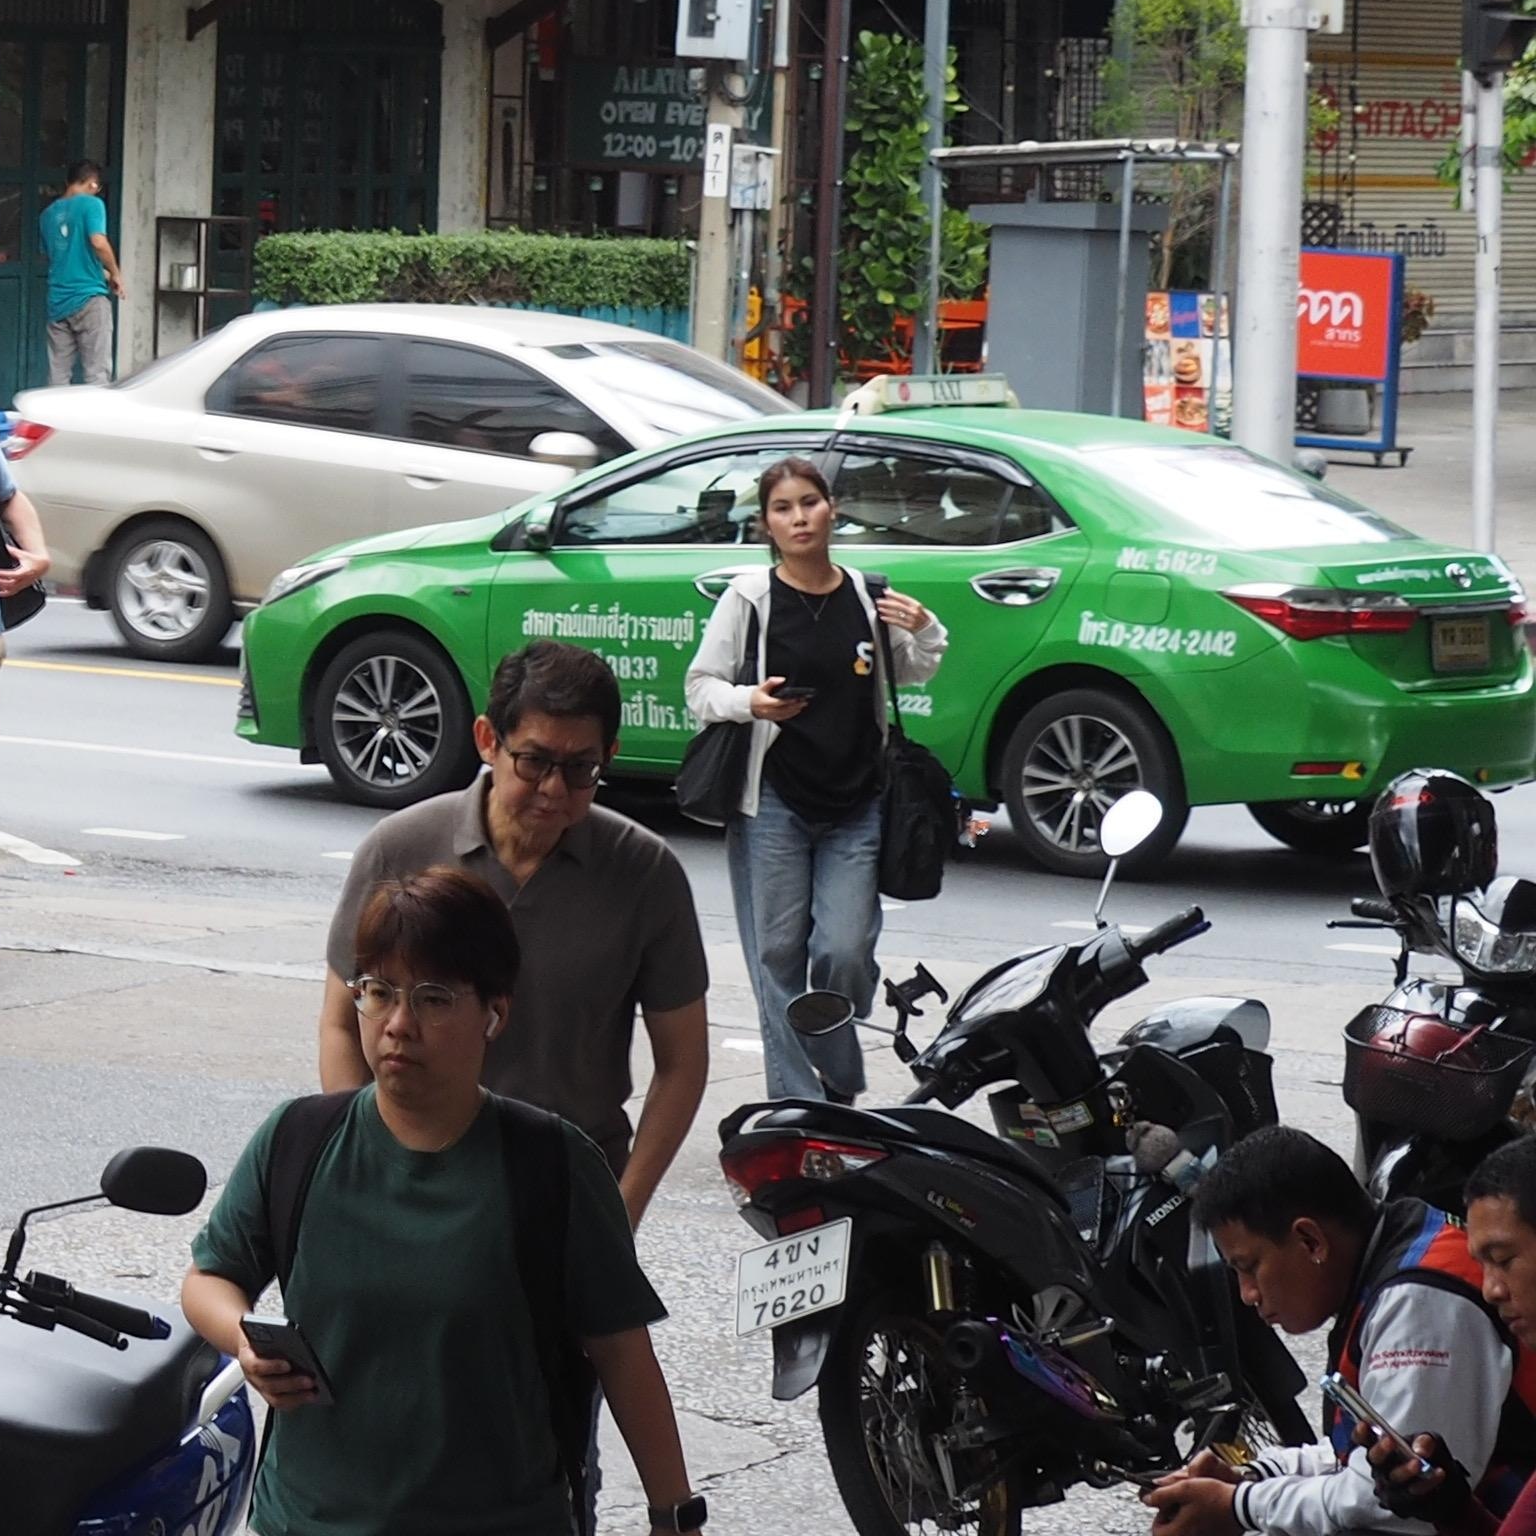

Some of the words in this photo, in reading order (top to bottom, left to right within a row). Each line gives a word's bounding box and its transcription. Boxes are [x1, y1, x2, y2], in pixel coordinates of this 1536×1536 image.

[600, 101, 657, 125] OPEN
[929, 380, 963, 401] TAXI
[742, 1257, 841, 1302] กรุงเทพมหานคร
[753, 1284, 826, 1326] 7620
